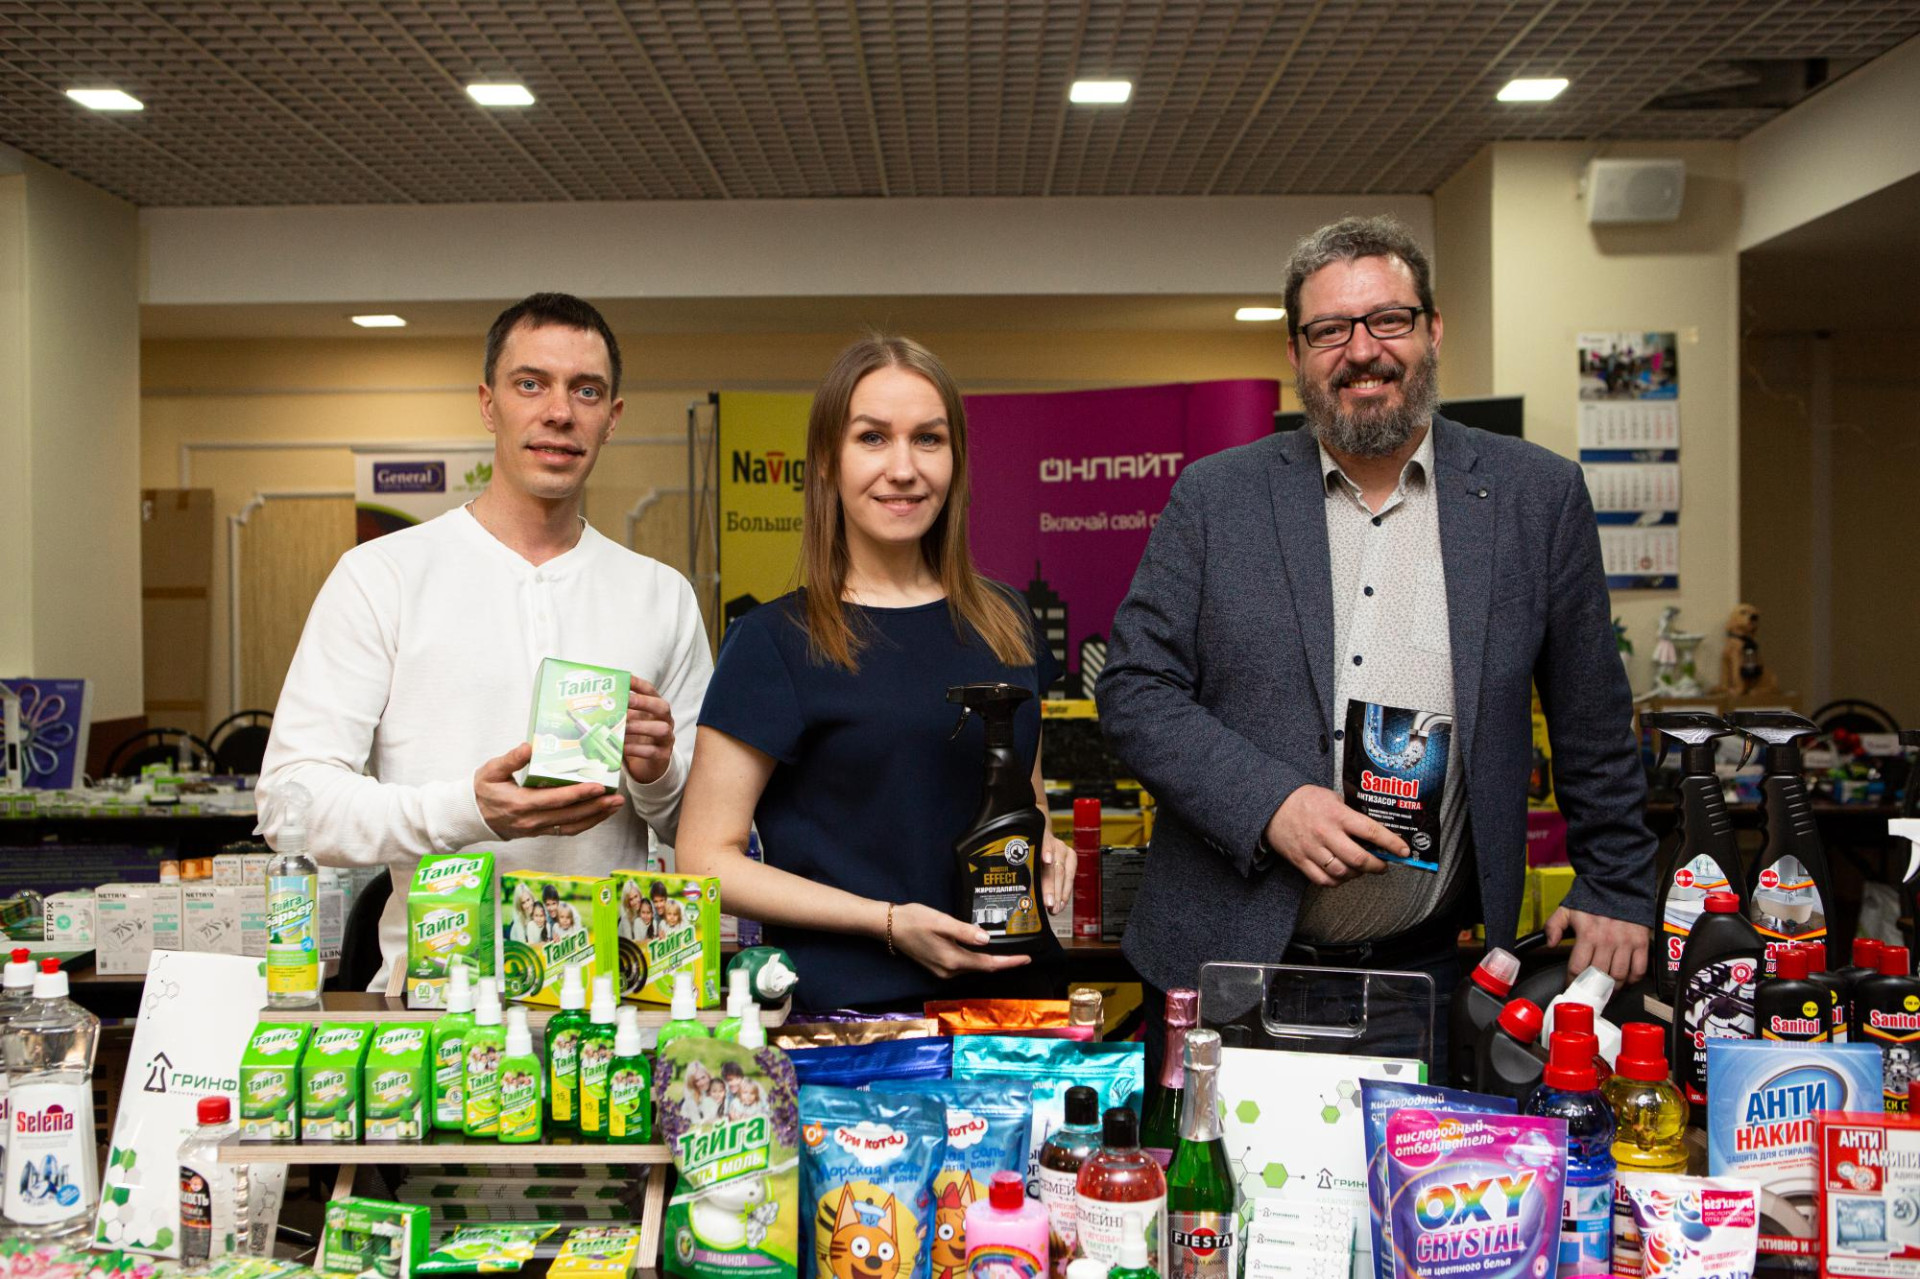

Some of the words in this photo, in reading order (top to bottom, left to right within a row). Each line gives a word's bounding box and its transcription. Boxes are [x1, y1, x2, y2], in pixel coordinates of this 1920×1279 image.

[377, 469, 432, 485] General
[1040, 452, 1183, 482] ОНЛАЙТ
[727, 511, 803, 532] Больше
[1040, 512, 1108, 532] Включай
[1110, 510, 1146, 530] свой
[558, 677, 614, 697] Тайга
[1361, 770, 1419, 799] Sanitol
[1356, 792, 1396, 806] АНТИЗАСОР
[1399, 800, 1422, 810] EXTRA
[420, 860, 479, 882] Тайга
[984, 872, 1017, 885] EFFECT
[417, 913, 466, 939] Тайга
[544, 930, 587, 964] Тайга
[649, 926, 694, 961] Тайга
[1771, 1015, 1820, 1034] Sanitol
[1870, 1009, 1920, 1029] Sanitol
[254, 1029, 299, 1046] Тайга
[316, 1029, 362, 1046] Тайга
[377, 1029, 422, 1046] Тайга
[249, 1073, 283, 1092] Тайга
[310, 1073, 344, 1093] Тайга
[374, 1074, 409, 1092] Тайга
[503, 1086, 532, 1102] Тайга
[1371, 1093, 1445, 1110] кислородный
[1746, 1081, 1826, 1122] АНТИ
[16, 1110, 73, 1133] Selena
[1395, 1120, 1483, 1144] кислородный
[1839, 1130, 1879, 1148] АНТИ
[679, 1117, 765, 1168] Тайга
[1395, 1135, 1495, 1157] отбеливатель
[721, 1154, 760, 1175] МОЛЬ
[1727, 1153, 1758, 1164] ЗАЩИТА
[1760, 1151, 1776, 1160] ДЛЯ
[1415, 1170, 1537, 1232] OXY
[1174, 1231, 1231, 1248] FIESTA
[1416, 1222, 1522, 1263] CRYSTAL
[1801, 1241, 1809, 1252] И
[706, 1251, 748, 1266] ЛАВАНДА
[1416, 1266, 1432, 1276] для
[1434, 1261, 1481, 1276] цветного
[1484, 1257, 1512, 1269] белья
